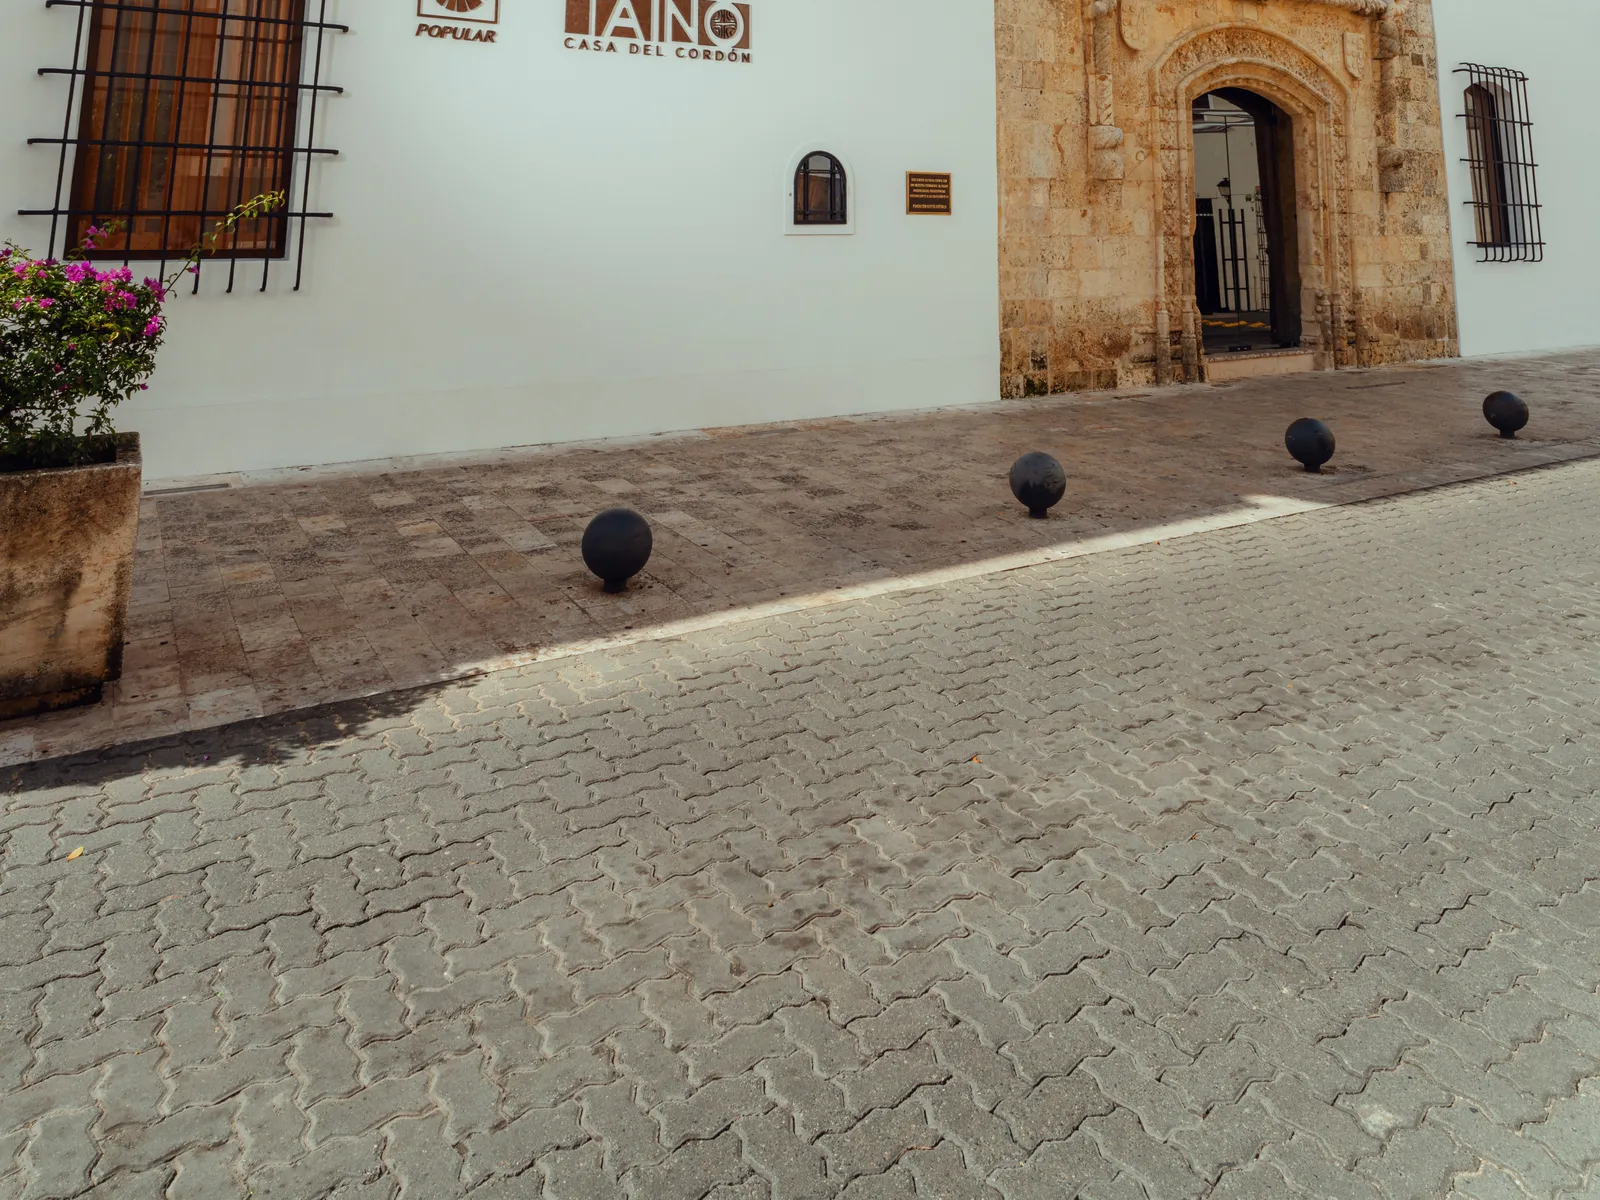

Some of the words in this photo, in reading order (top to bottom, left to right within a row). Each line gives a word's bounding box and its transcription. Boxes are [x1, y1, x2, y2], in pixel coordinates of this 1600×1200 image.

[415, 23, 497, 43] POPULAR
[564, 37, 617, 53] CASA
[629, 43, 664, 57] DEL
[675, 46, 751, 63] CORDÓN
